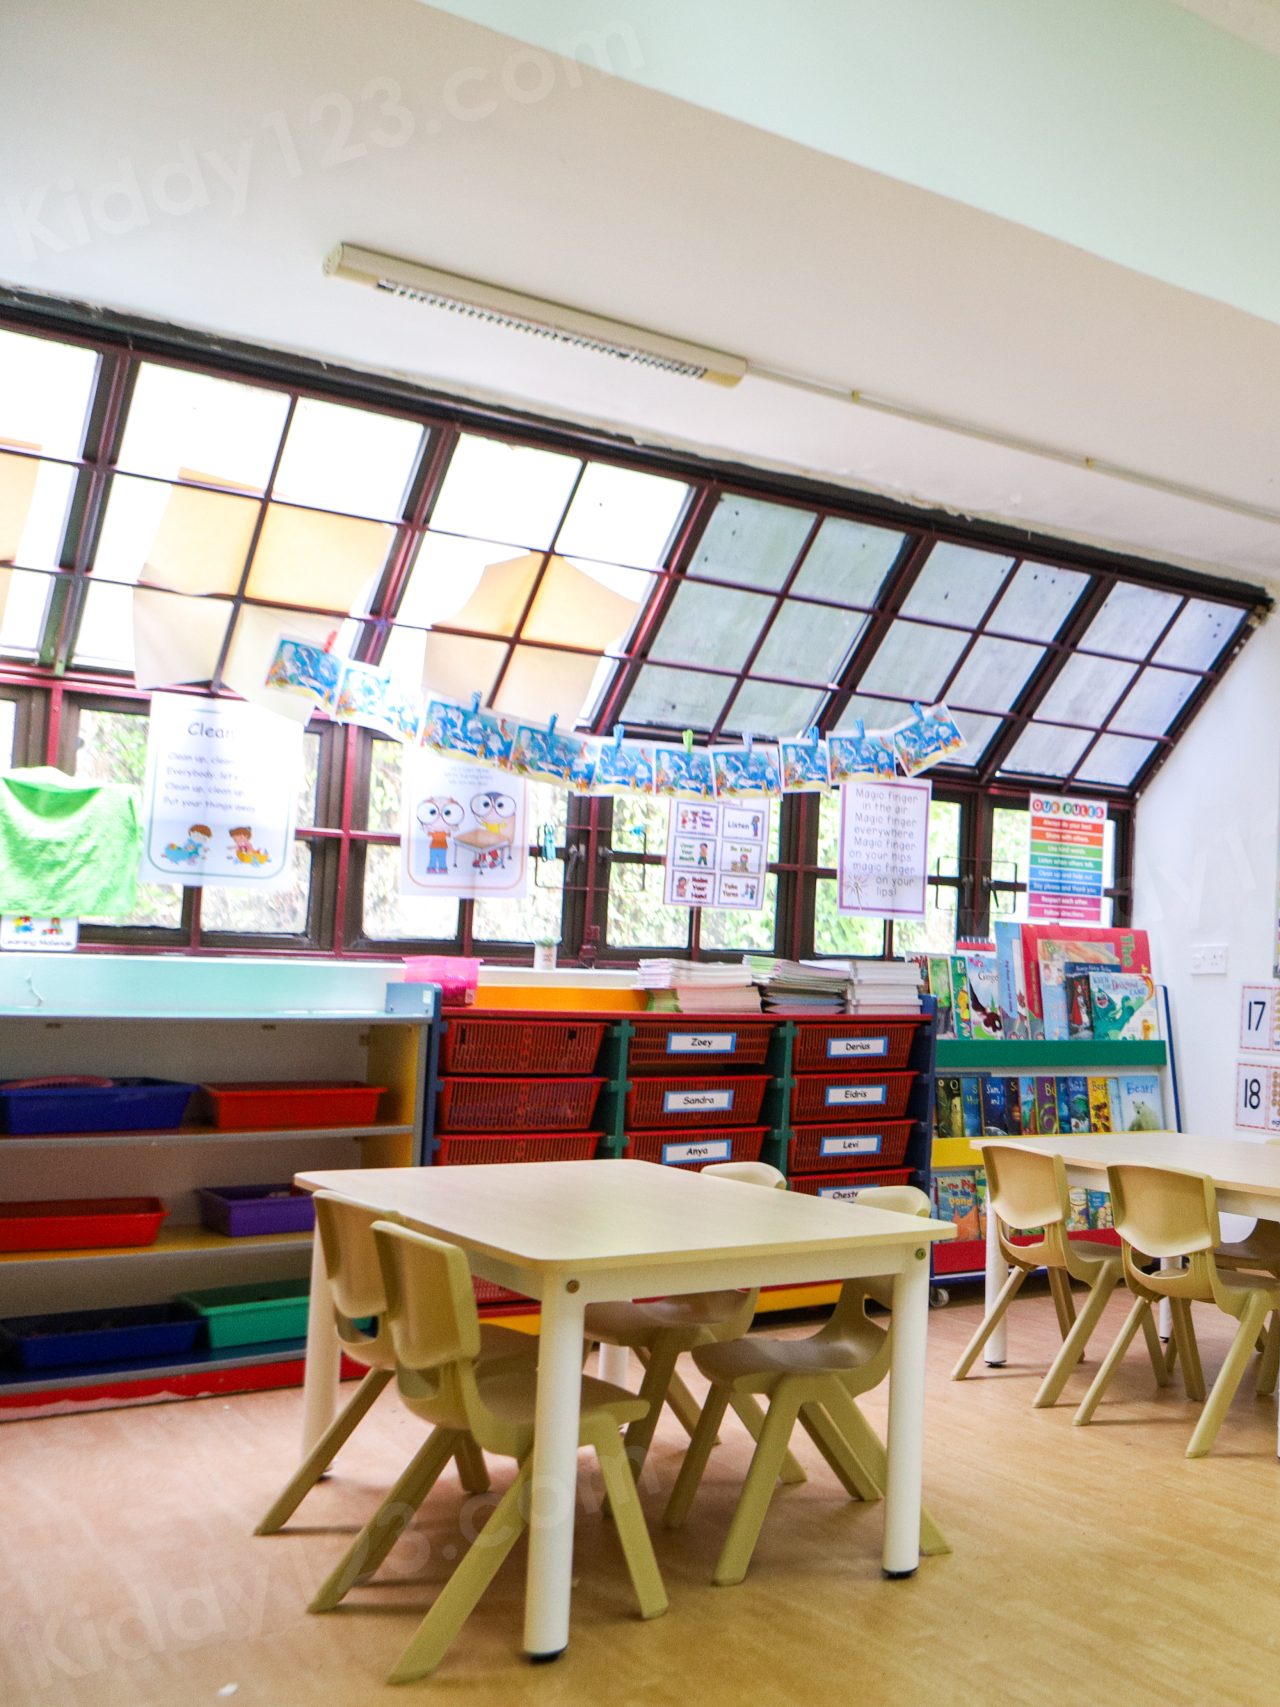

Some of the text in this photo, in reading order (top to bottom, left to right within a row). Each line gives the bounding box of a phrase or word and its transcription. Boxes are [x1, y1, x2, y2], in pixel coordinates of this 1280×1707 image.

[855, 788, 918, 804] Magic finger
[862, 802, 908, 813] in the air
[1033, 799, 1104, 819] OUR RULES
[727, 821, 749, 830] Listen
[855, 812, 917, 828] Magic finger
[854, 825, 914, 839] everywhere
[854, 837, 916, 851] Magic finger
[849, 849, 861, 858] on
[865, 850, 888, 861] your
[853, 861, 915, 875] magic finger
[876, 876, 914, 888] on your
[1248, 1001, 1266, 1032] 17
[691, 1038, 713, 1048] Zoey
[844, 1089, 867, 1099] Eidris
[1244, 1078, 1261, 1110] 18
[682, 1096, 715, 1105] Sandra
[843, 1140, 859, 1149] Levi
[686, 1146, 708, 1157] Anya
